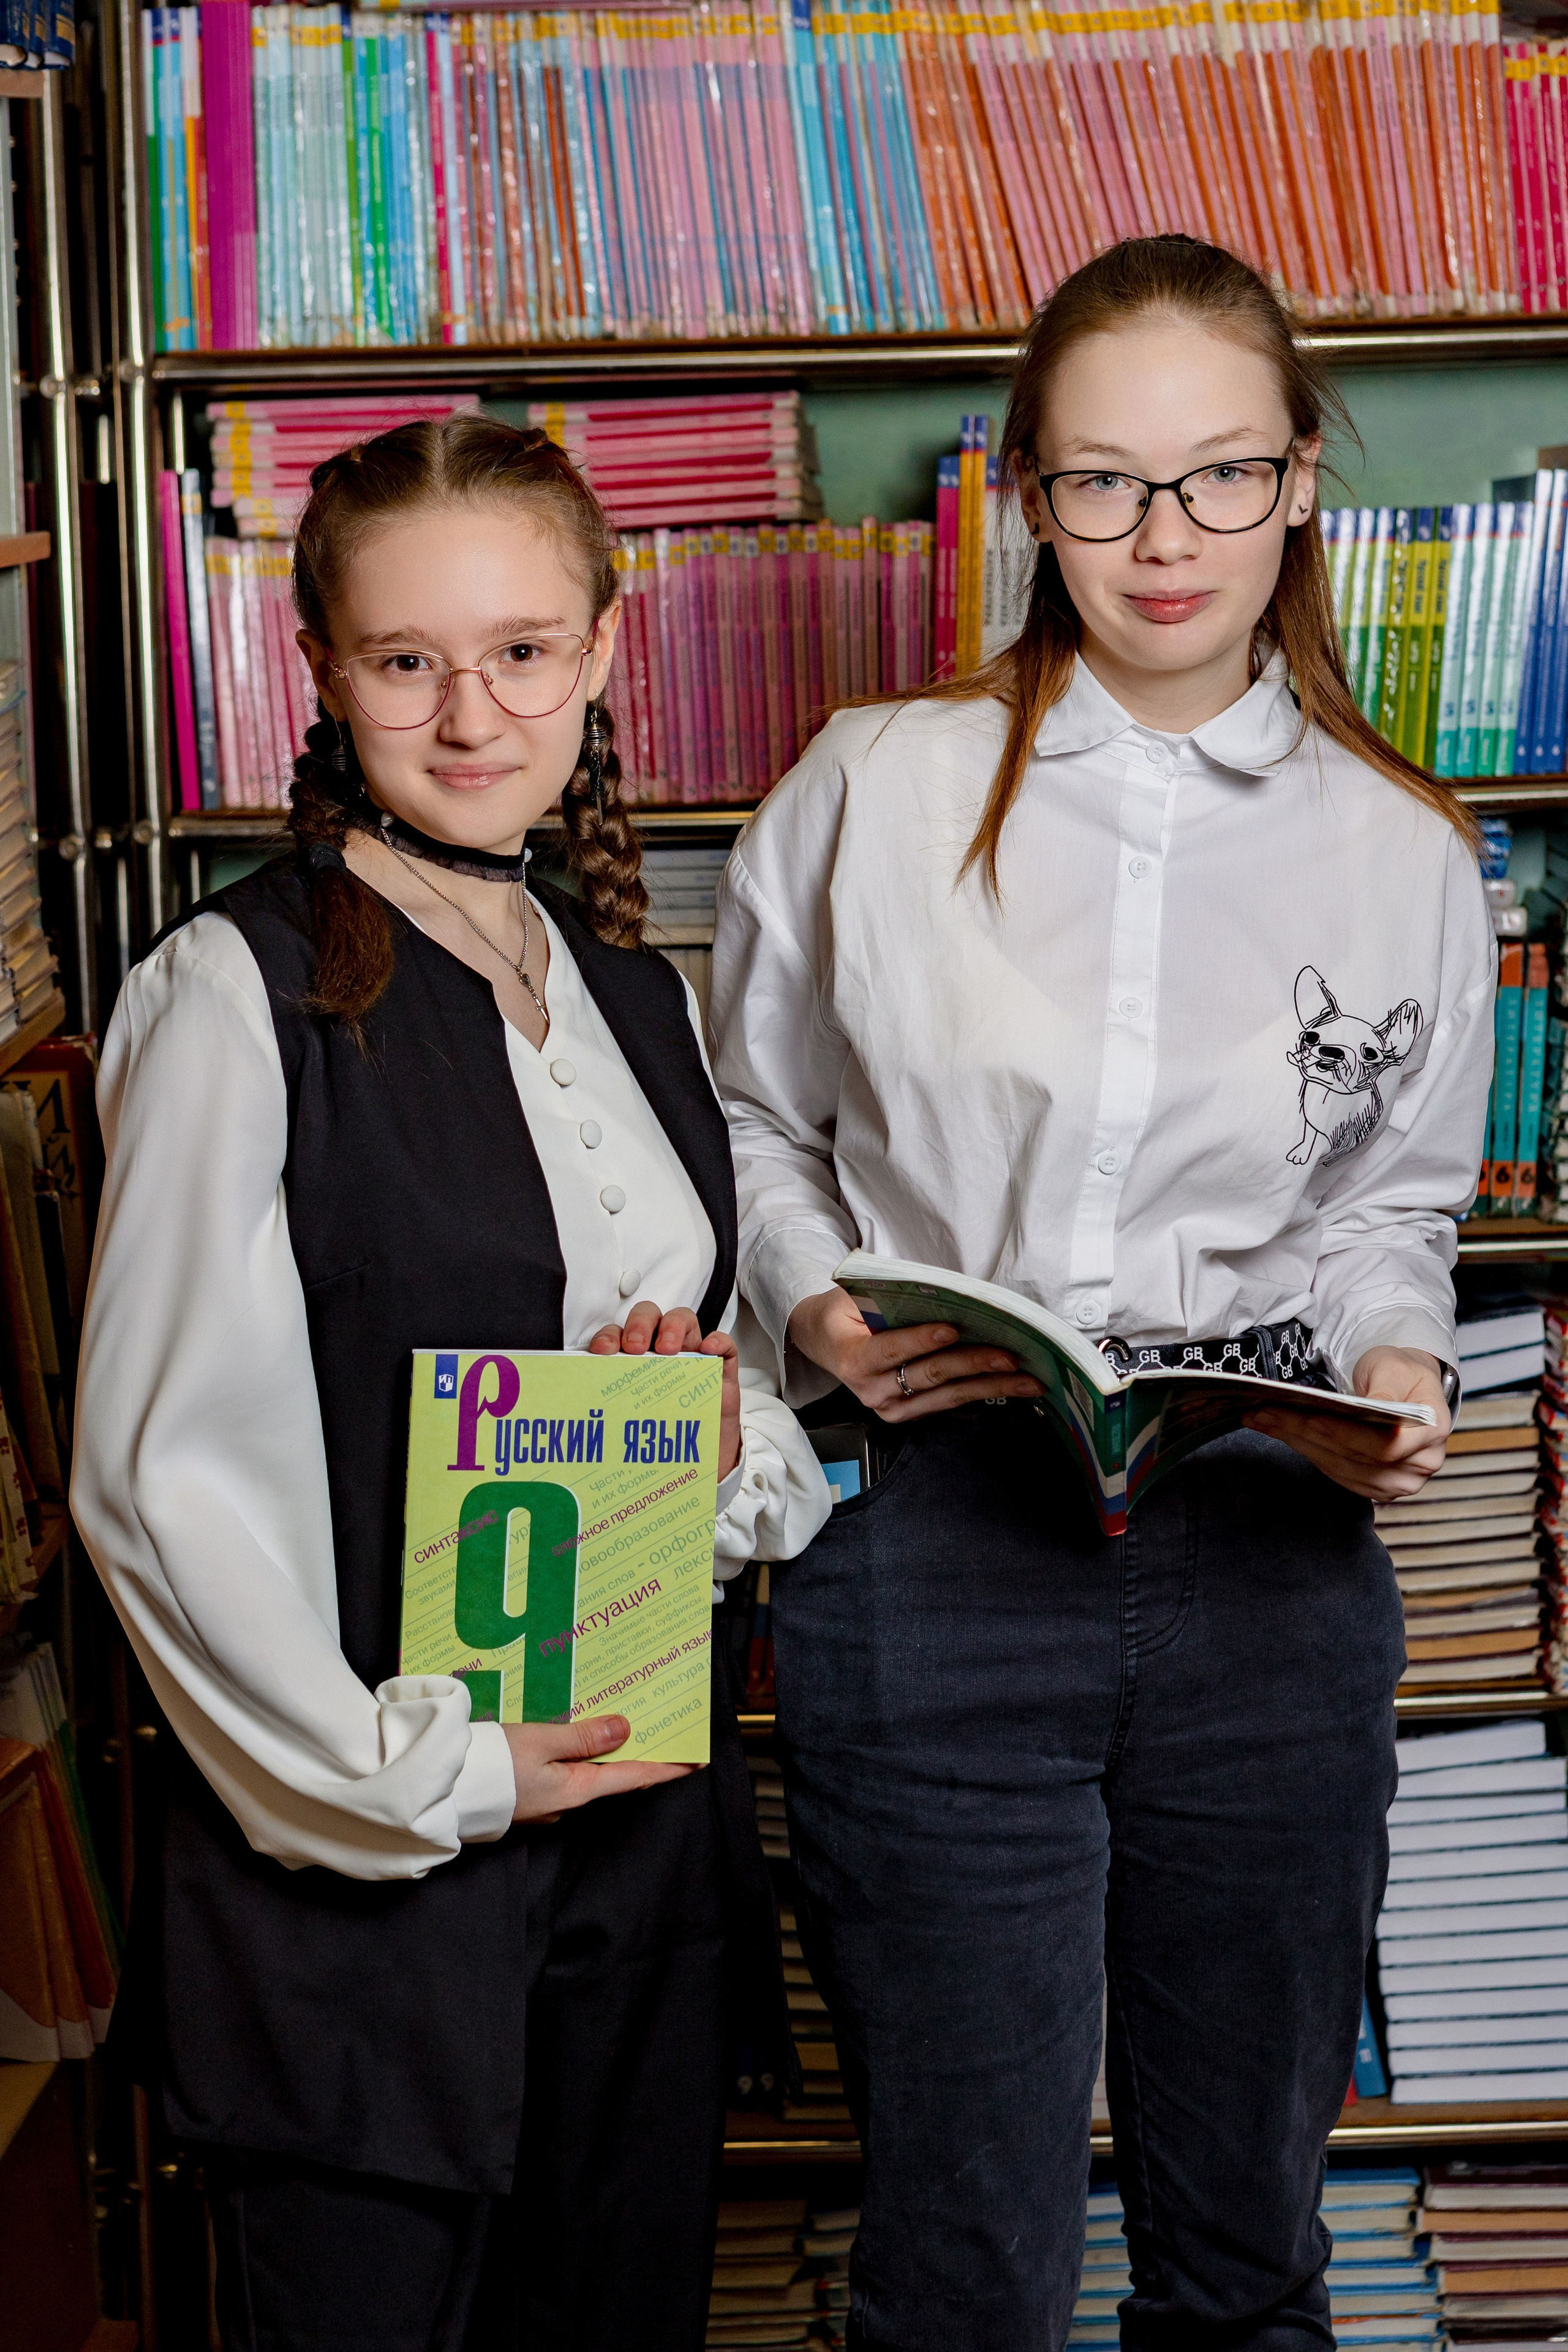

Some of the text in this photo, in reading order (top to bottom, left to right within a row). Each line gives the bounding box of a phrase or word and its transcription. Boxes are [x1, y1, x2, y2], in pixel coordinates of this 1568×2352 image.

[1496, 1166, 1510, 1183] 6
[1521, 1167, 1534, 1184] 6
[1223, 1343, 1241, 1357] GB
[1281, 1330, 1289, 1344] GB
[1290, 1344, 1298, 1359] GB
[1139, 1349, 1161, 1363] GB
[1183, 1347, 1204, 1361] GB
[1239, 1359, 1256, 1372] GB
[1273, 1351, 1281, 1365] B
[601, 1357, 666, 1396] морфемика
[630, 1376, 659, 1396] Части
[659, 1360, 682, 1380] речи
[642, 1394, 653, 1405] их
[654, 1372, 686, 1398] формы
[1282, 1365, 1293, 1379] GB
[447, 1354, 701, 1476] Русский язык
[589, 1470, 625, 1492] Части
[552, 1469, 698, 1557] сложное предложение
[592, 1501, 601, 1509] и
[601, 1491, 616, 1504] их
[414, 1510, 499, 1564] синтаксис
[578, 1588, 606, 1609] ания
[608, 1569, 635, 1590] слов
[649, 1519, 715, 1565] орфогр
[418, 1580, 456, 1605] звуками
[454, 1481, 581, 1723] 9
[405, 1607, 455, 1640] Расстанов
[540, 1578, 662, 1657] пунктуация
[599, 1584, 699, 1646] Значимые части слова
[605, 1626, 655, 1657] приставки,
[655, 1596, 705, 1627] суффиксы,
[401, 1634, 452, 1666] Части речи
[590, 1653, 629, 1679] способы
[630, 1619, 688, 1655] образования
[688, 1605, 710, 1621] слов
[410, 1664, 421, 1674] их
[423, 1645, 455, 1667] формы
[547, 1700, 585, 1724] ский
[586, 1646, 681, 1709] литературный
[652, 1662, 705, 1698] культура
[635, 1698, 703, 1745] фонетика
